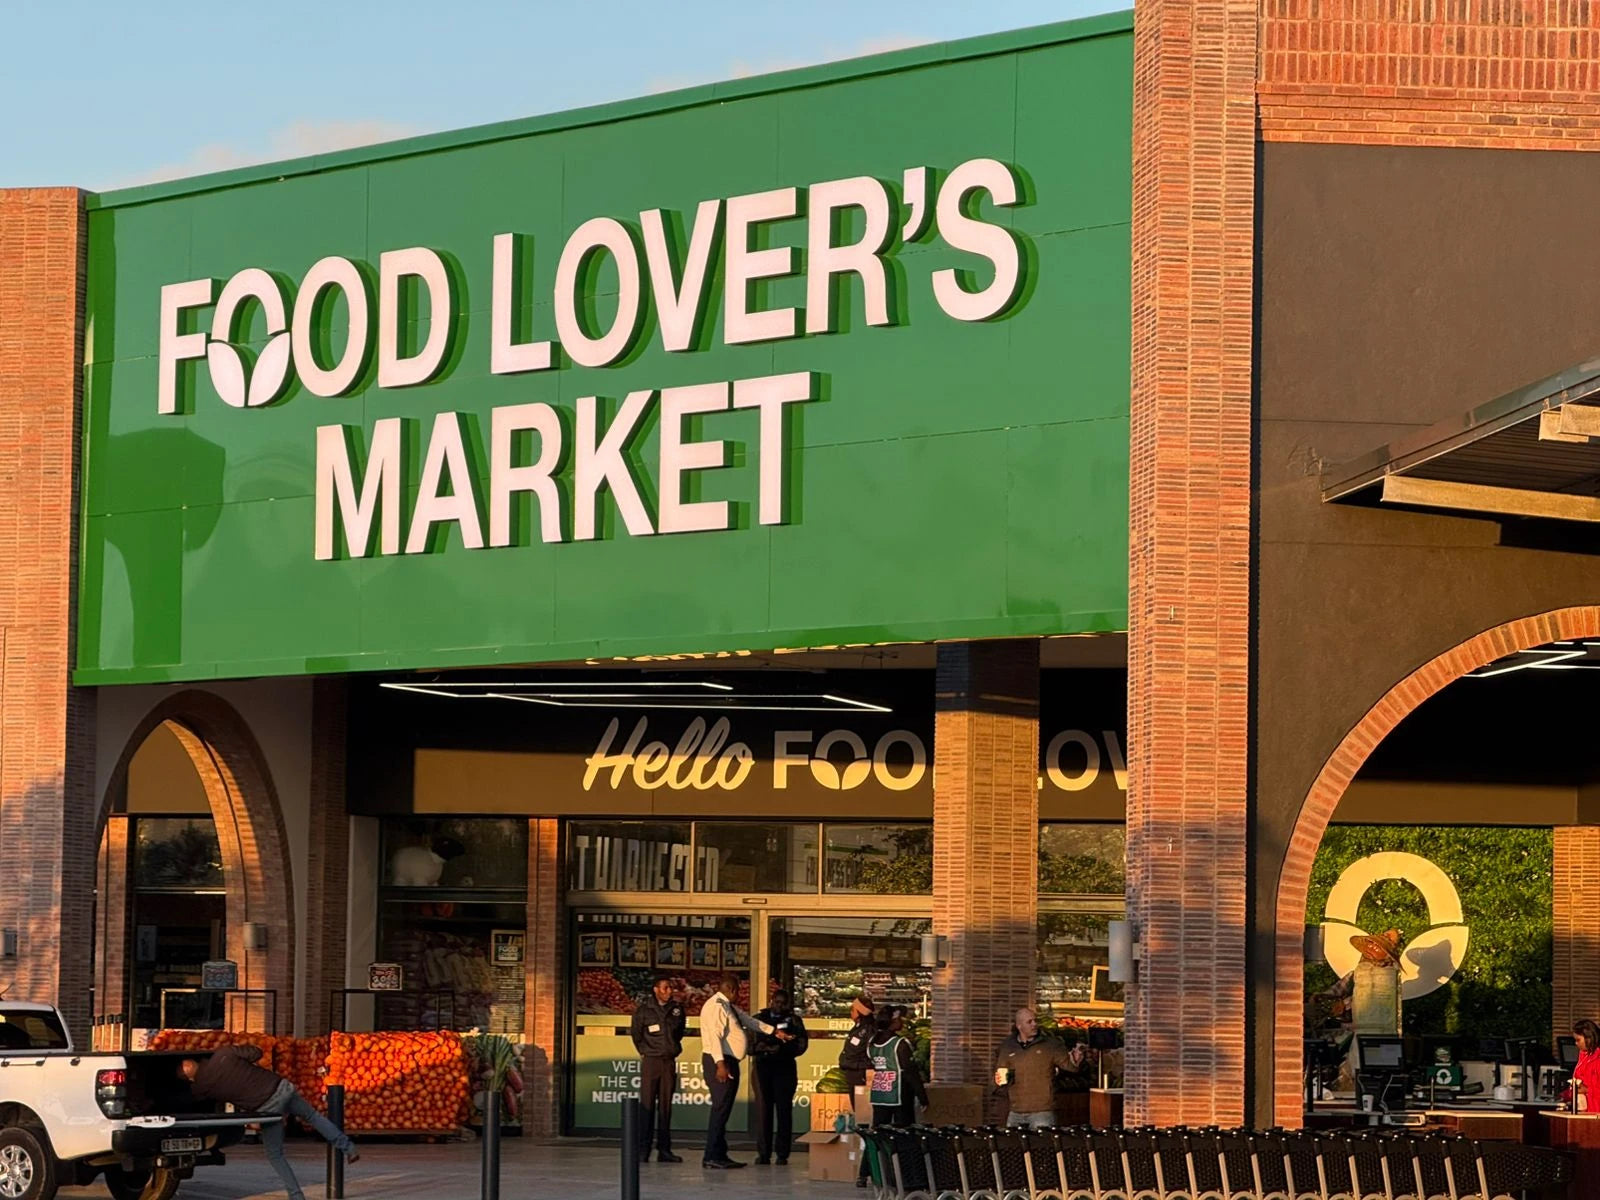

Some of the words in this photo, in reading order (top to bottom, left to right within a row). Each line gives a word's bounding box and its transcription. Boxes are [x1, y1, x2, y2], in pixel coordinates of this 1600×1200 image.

[157, 246, 452, 415] FOOD
[491, 158, 1021, 375] LOVER'S
[314, 371, 812, 561] MARKET
[582, 716, 756, 791] Hello
[773, 729, 936, 791] FOO
[598, 1075, 628, 1088] THE
[810, 1064, 840, 1076] TH
